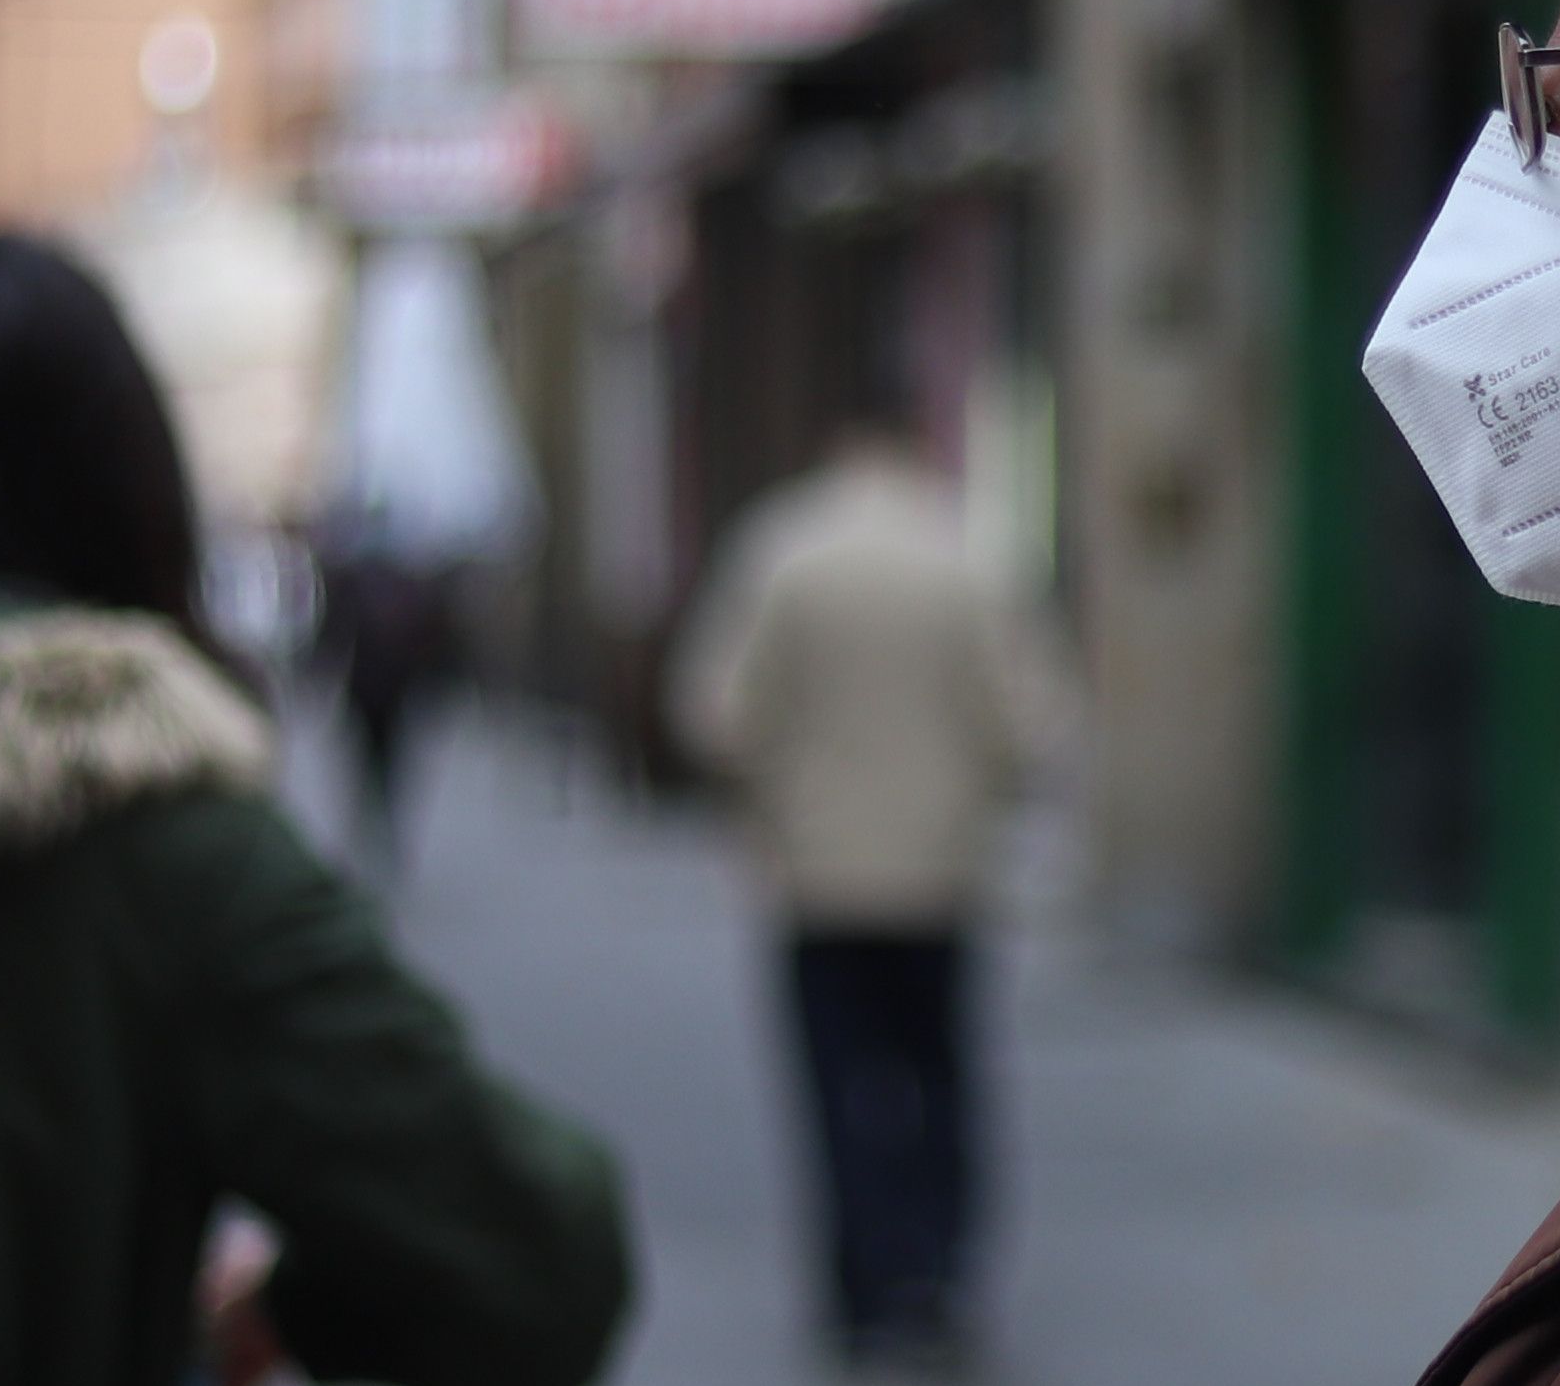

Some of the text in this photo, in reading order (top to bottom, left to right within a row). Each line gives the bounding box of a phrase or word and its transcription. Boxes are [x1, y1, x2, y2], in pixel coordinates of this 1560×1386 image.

[1488, 348, 1551, 387] Star Care
[1515, 376, 1559, 412] 2163
